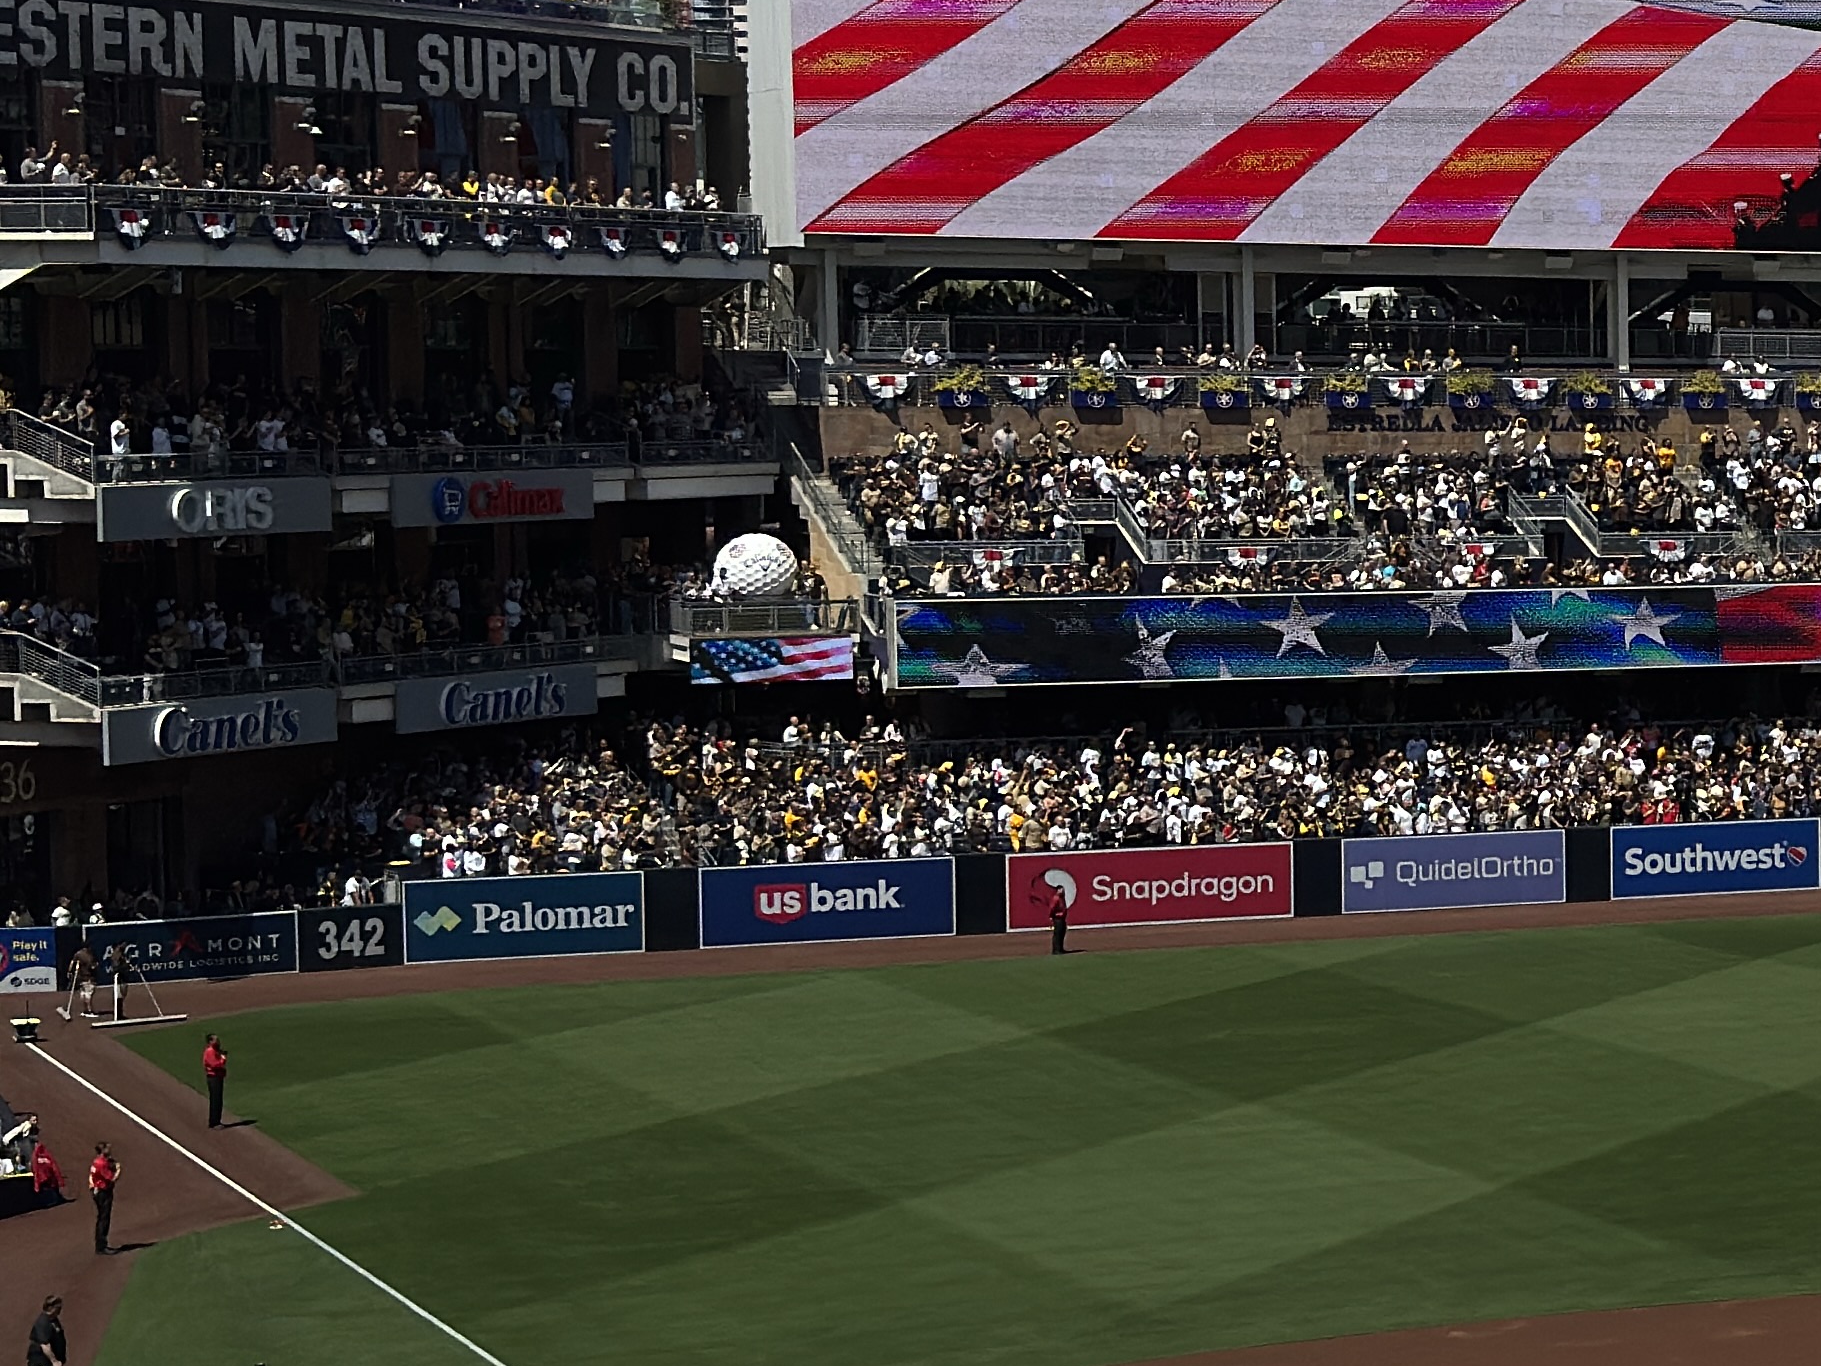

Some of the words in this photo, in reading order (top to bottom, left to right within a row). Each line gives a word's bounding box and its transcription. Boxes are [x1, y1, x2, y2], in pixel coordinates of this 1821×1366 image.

[233, 16, 403, 94] METAL
[418, 33, 598, 109] SUPPLY
[618, 51, 690, 115] CO.
[1327, 414, 1445, 432] ESTRELLA
[171, 486, 273, 533] ORIS
[440, 672, 567, 727] Canel's
[154, 698, 301, 760] Canel's
[1396, 853, 1555, 887] QuidelOrtho
[1624, 840, 1785, 876] Southwest
[759, 890, 802, 916] us
[810, 879, 902, 914] bank
[1091, 872, 1275, 906] Snapdragon
[472, 901, 634, 935] Palomar
[12, 939, 37, 953] Play
[37, 939, 48, 950] it
[318, 917, 385, 961] 342
[12, 951, 40, 963] safe.
[189, 954, 254, 970] LOGISTICS
[258, 952, 280, 963] INC
